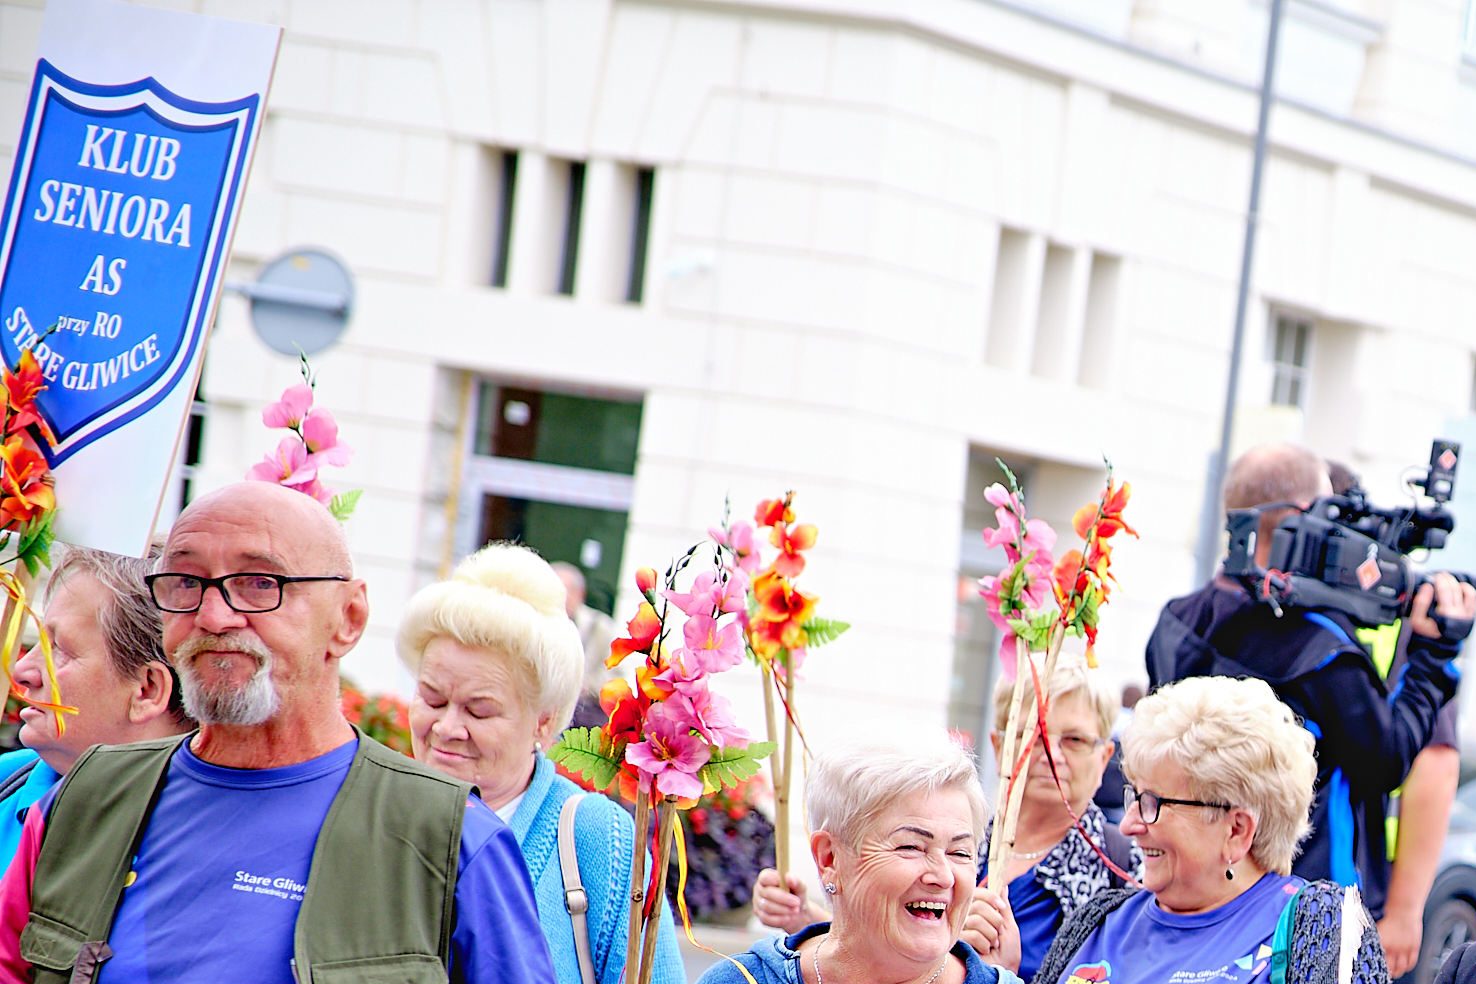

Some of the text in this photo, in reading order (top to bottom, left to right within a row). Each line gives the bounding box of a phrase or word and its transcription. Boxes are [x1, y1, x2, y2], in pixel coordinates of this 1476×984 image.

[78, 124, 181, 181] KLUB
[33, 179, 192, 248] SENIORA
[79, 254, 127, 296] AS
[5, 306, 161, 391] STARE GLIWICE
[55, 311, 122, 339] przy RO
[234, 870, 272, 887] Stare
